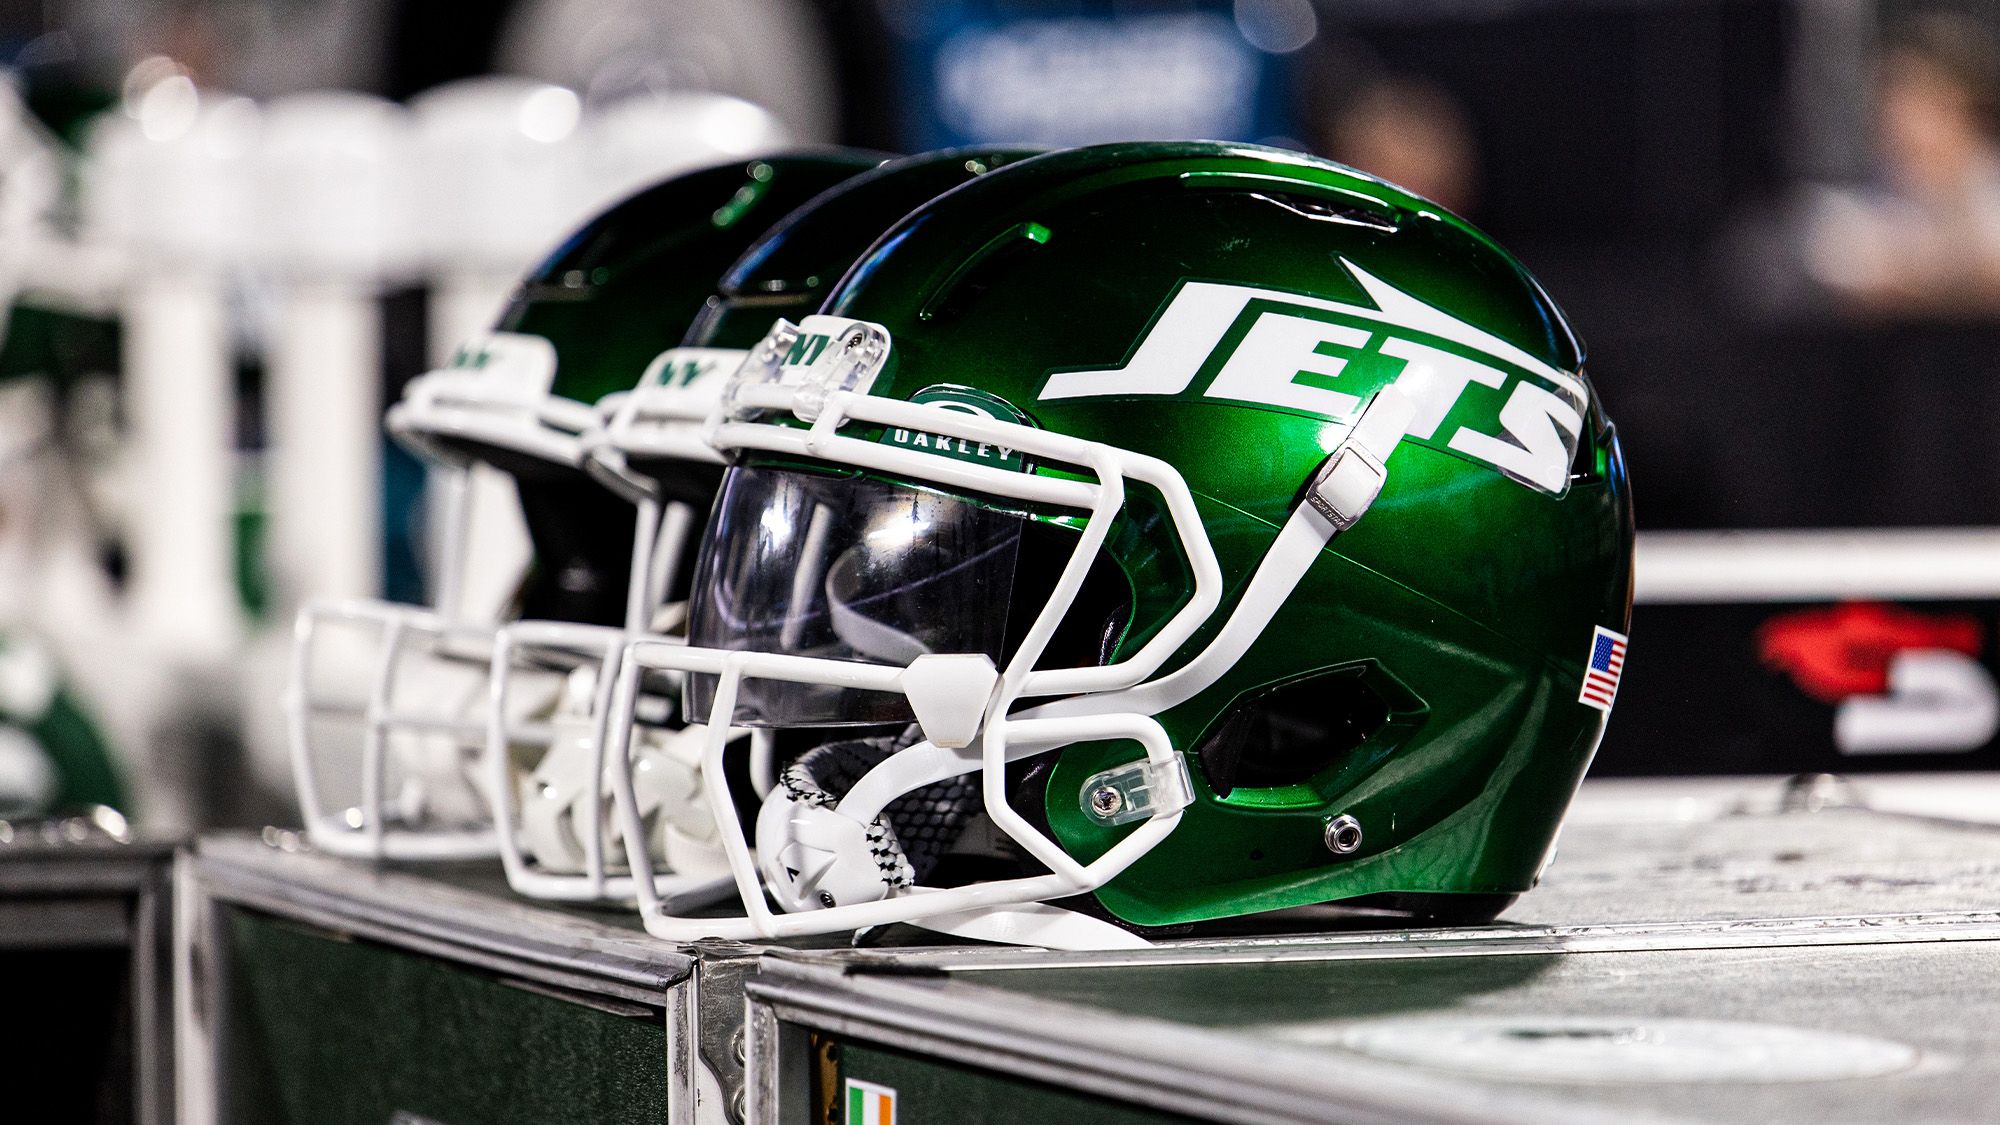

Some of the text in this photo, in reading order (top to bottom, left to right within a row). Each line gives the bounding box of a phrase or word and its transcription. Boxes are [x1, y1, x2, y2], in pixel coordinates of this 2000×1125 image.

[1037, 256, 1588, 495] JETS
[894, 428, 1013, 461] OAKLEY
[1310, 496, 1345, 527] SPORTSTAR
